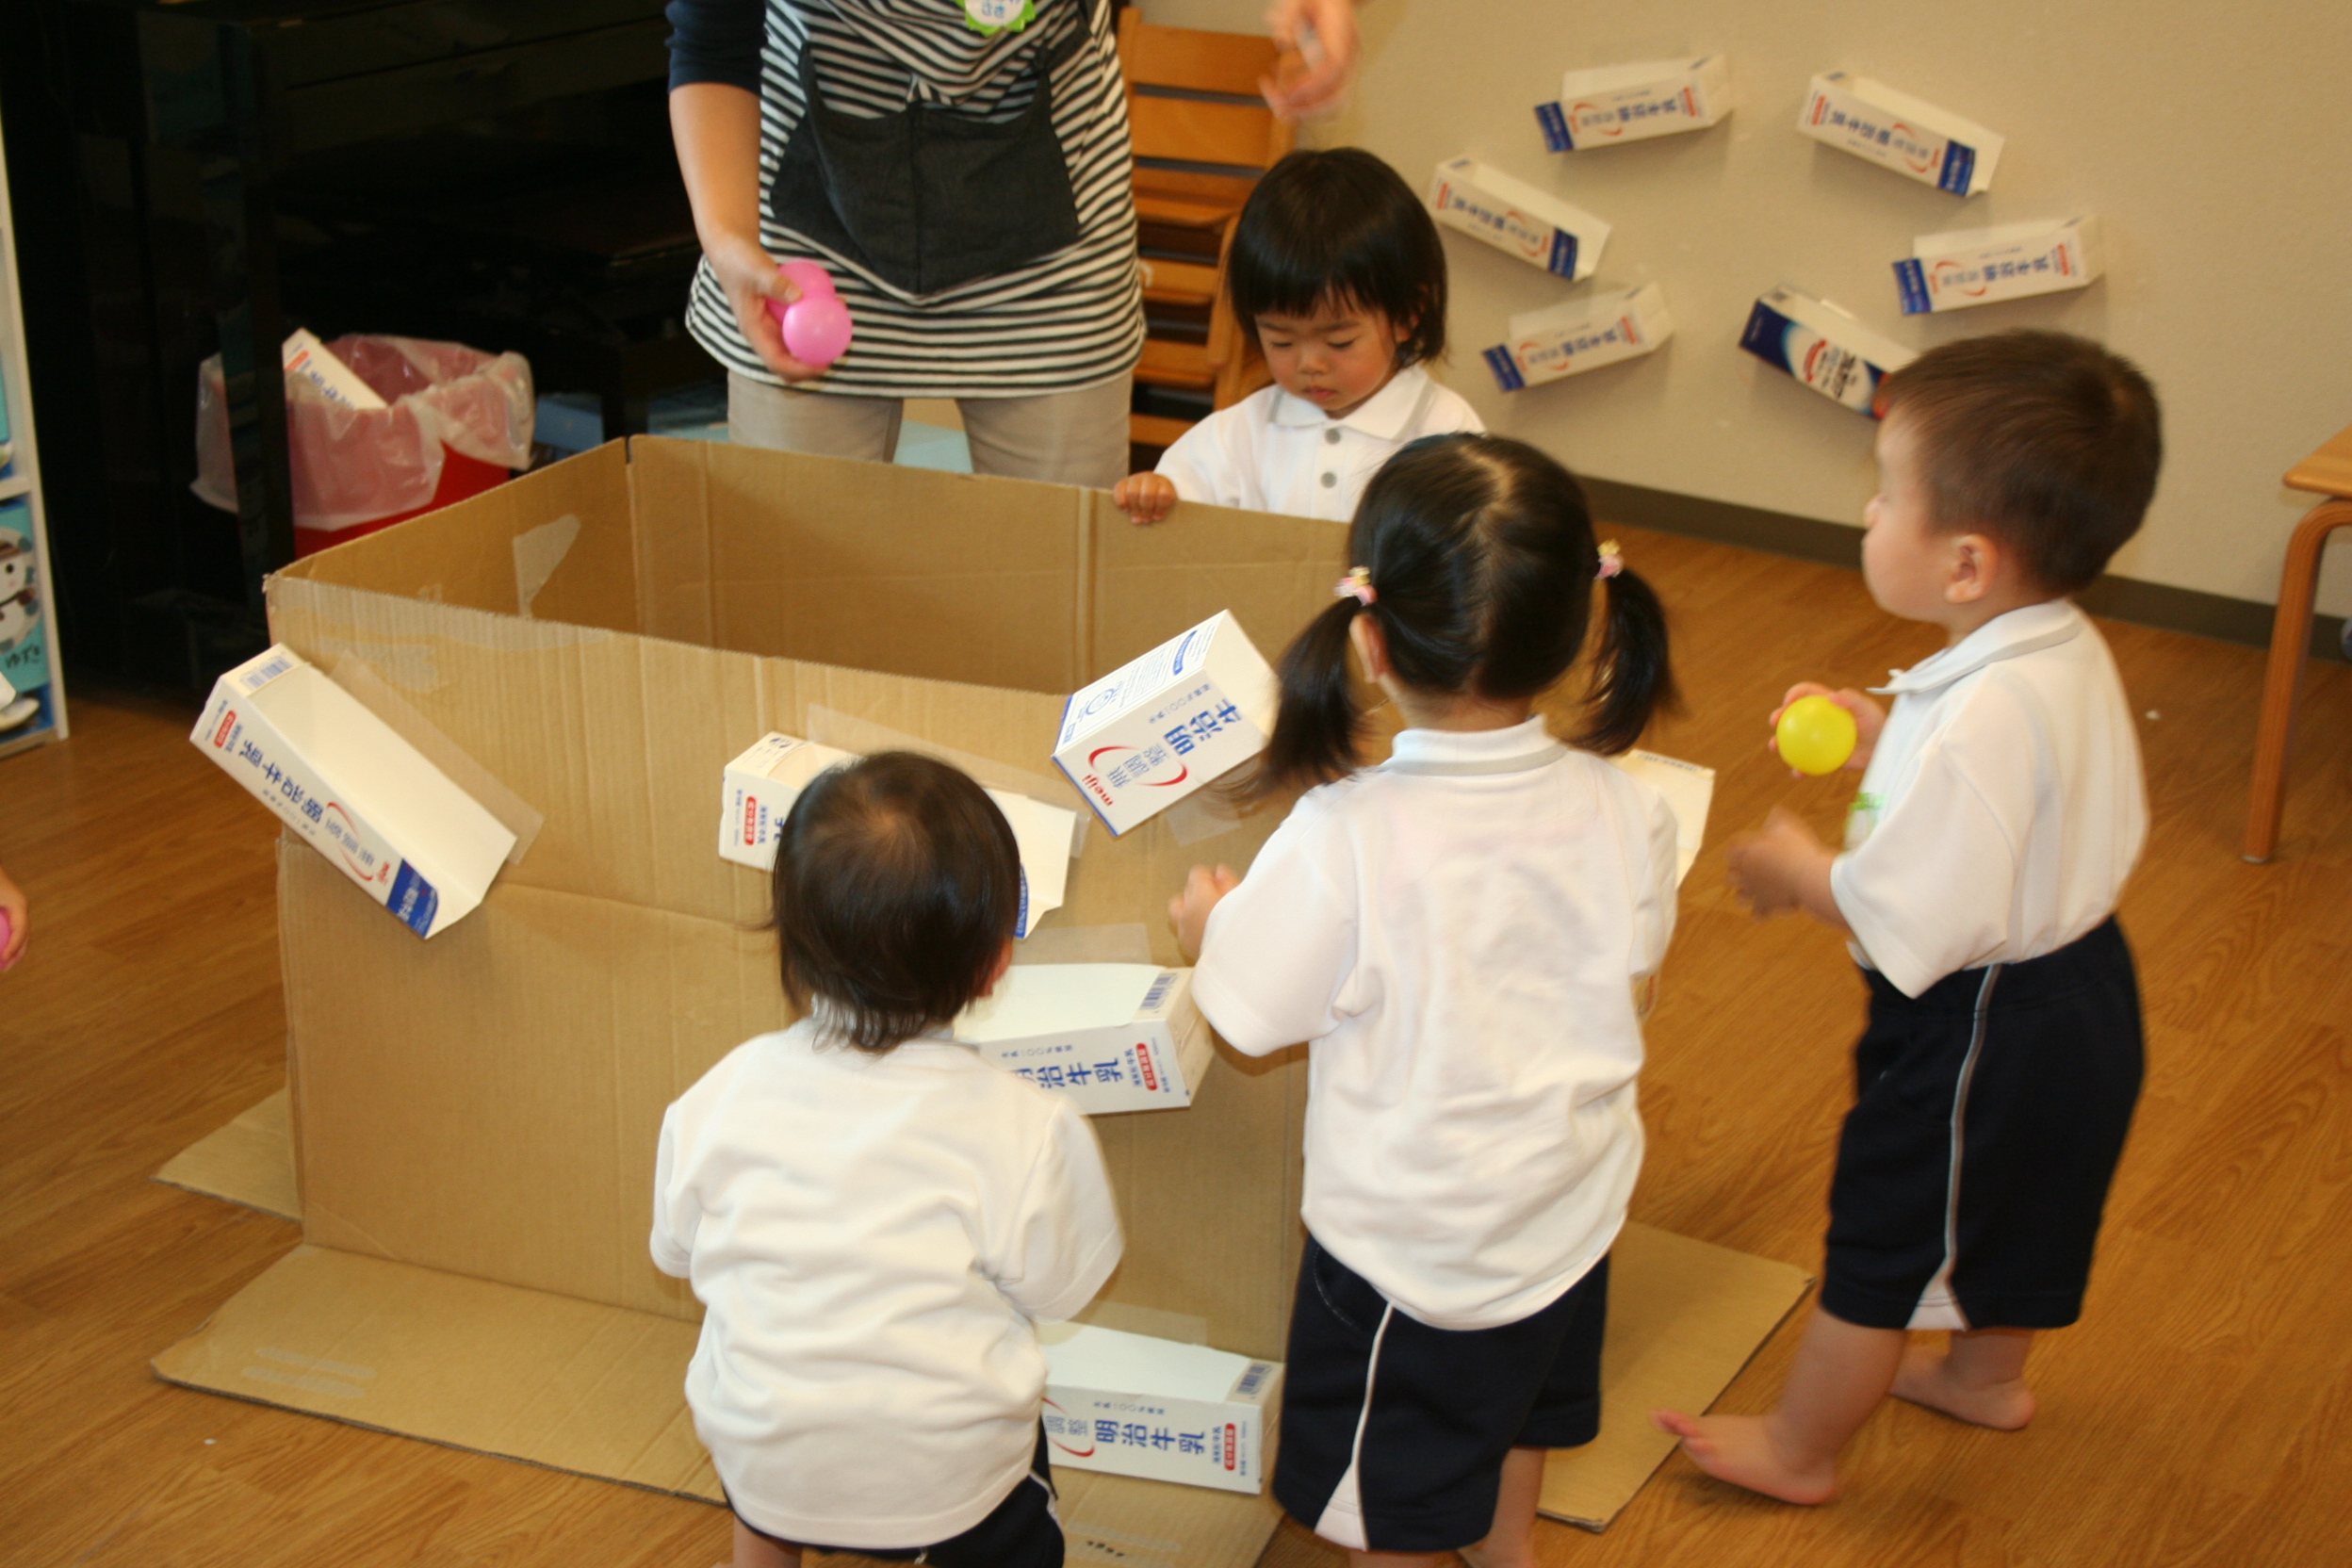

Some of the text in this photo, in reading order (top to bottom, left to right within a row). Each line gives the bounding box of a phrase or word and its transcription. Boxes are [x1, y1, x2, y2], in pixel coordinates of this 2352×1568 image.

[1083, 775, 1115, 807] meiji
[1095, 1419, 1205, 1455] 明治牛乳
